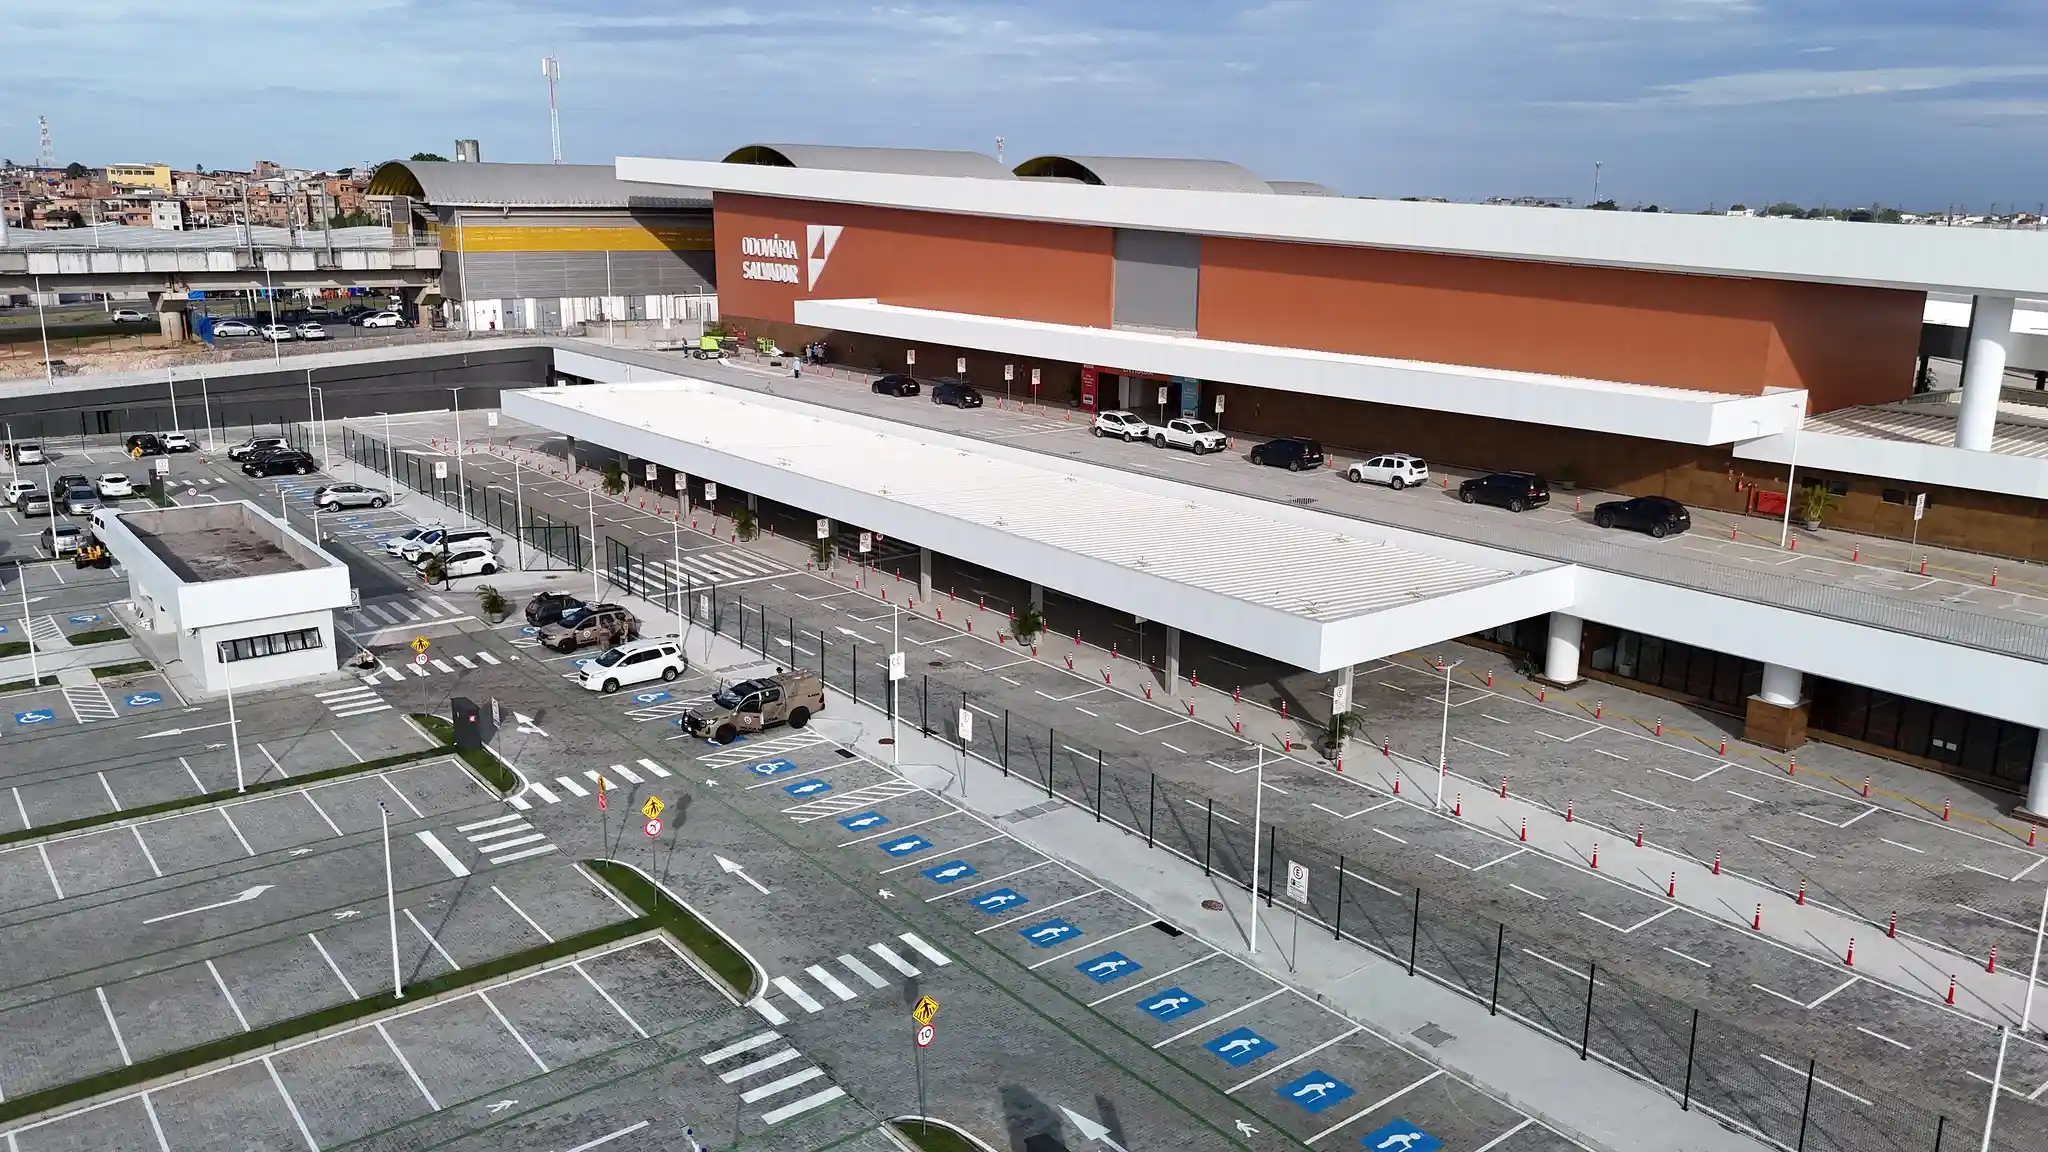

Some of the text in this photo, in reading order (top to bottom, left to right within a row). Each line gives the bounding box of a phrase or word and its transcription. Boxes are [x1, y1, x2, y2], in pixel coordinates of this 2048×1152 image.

[742, 233, 799, 260] ODOVIÁRIA
[742, 261, 799, 284] SALVADOR
[921, 1028, 932, 1041] 10
